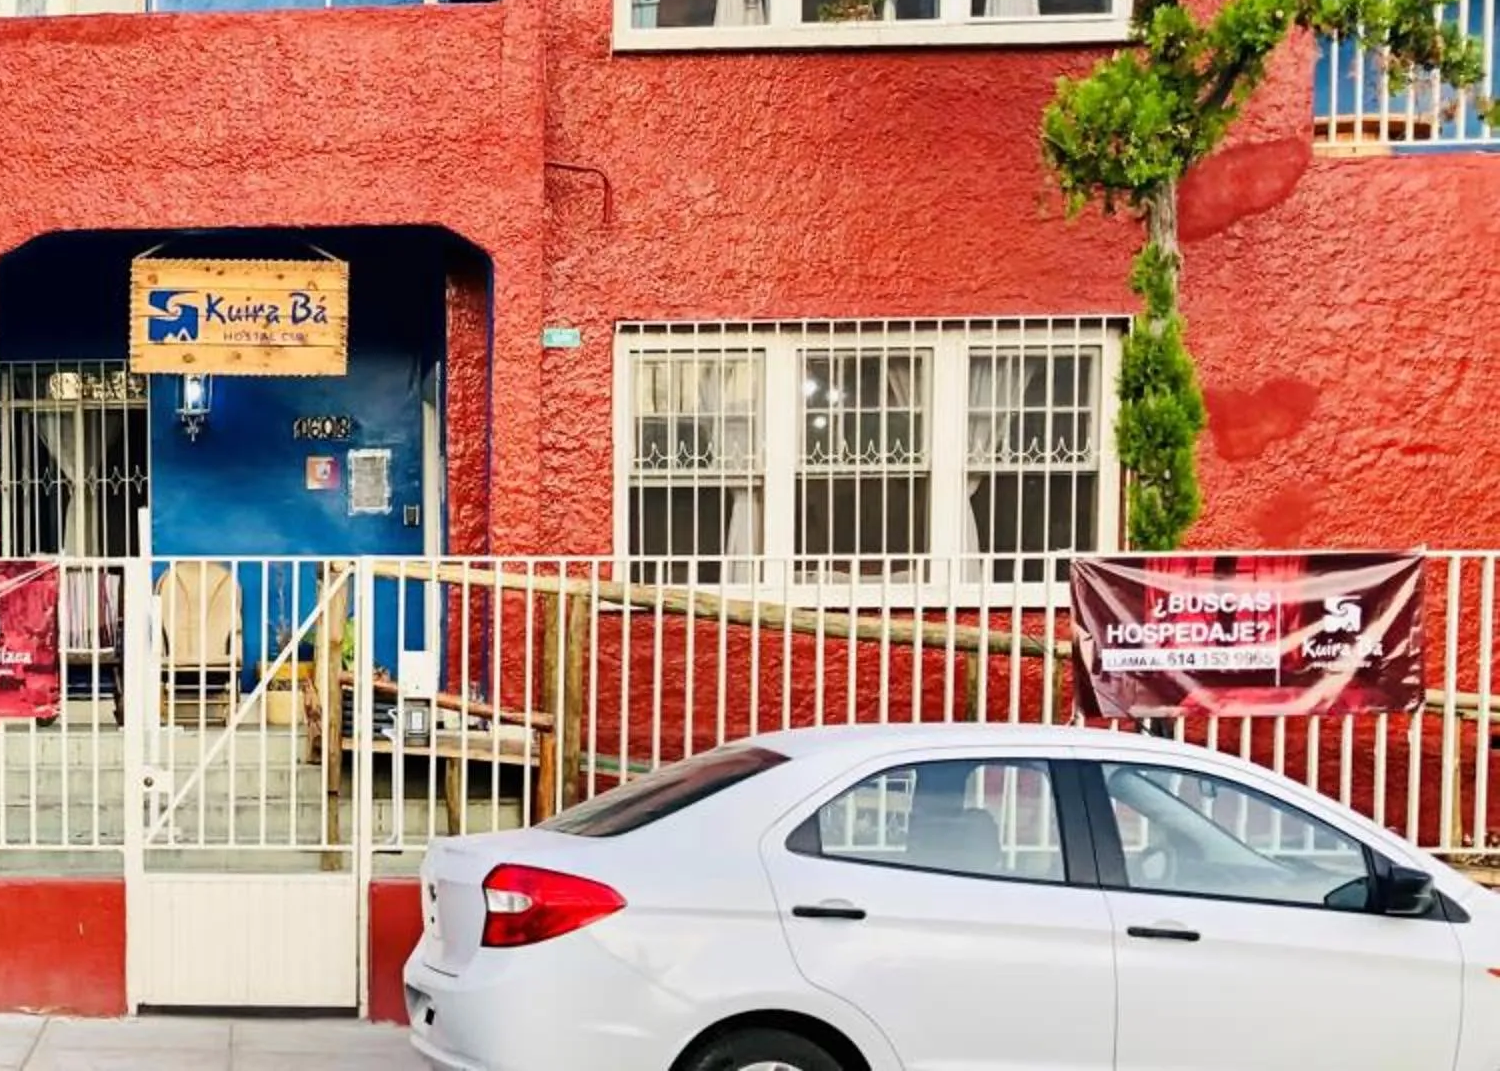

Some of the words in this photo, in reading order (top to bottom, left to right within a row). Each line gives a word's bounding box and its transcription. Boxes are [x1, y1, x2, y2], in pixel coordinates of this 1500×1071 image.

[205, 292, 280, 324] Kuira
[289, 291, 328, 325] Bá
[223, 331, 276, 341] HOSTAL
[1153, 592, 1273, 619] ¿BUSCAS
[1106, 621, 1270, 644] HOSPEDAJE?
[1301, 635, 1351, 658] Kuira
